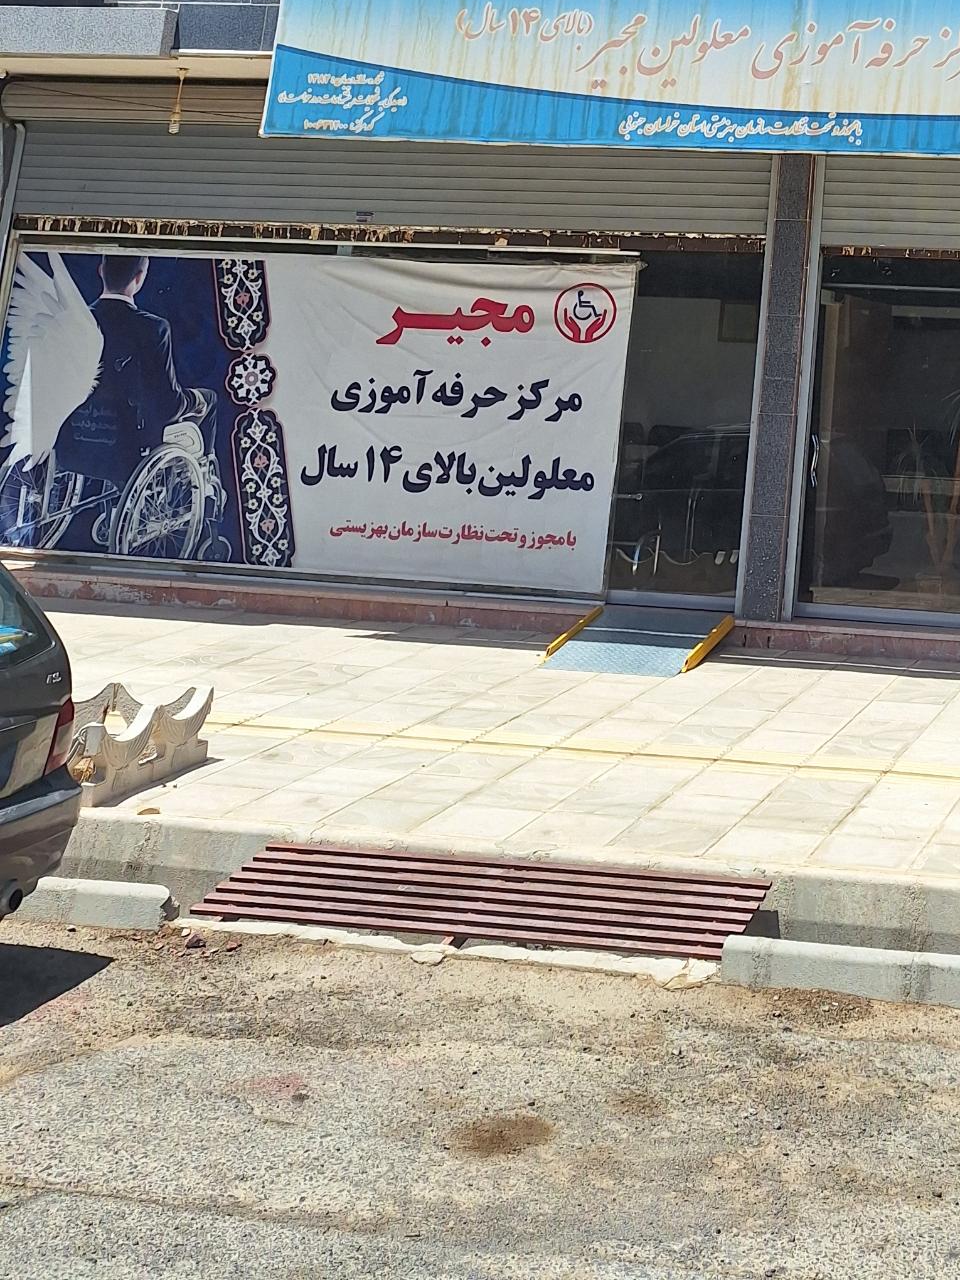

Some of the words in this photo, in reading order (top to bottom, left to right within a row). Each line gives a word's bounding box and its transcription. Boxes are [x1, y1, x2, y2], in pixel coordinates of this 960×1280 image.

[509, 8, 541, 36] ۱۴
[575, 14, 648, 89] مجیر
[636, 14, 750, 89] معلولین
[751, 18, 881, 80] آموزی
[865, 19, 930, 69] حرفه
[618, 111, 646, 141] جنوبی
[644, 111, 681, 136] خراسان
[375, 296, 535, 346] مجیر
[330, 370, 433, 414] آموزی
[431, 371, 508, 419] حرفه
[507, 379, 583, 422] مرکز
[300, 444, 358, 486] سال
[366, 444, 403, 484] ۱۴
[402, 450, 477, 494] بالای
[477, 455, 595, 500] معلولین
[329, 519, 388, 540] بهزیستی
[388, 520, 438, 543] سازمان
[439, 524, 485, 545] نظارت
[484, 527, 519, 543] تحت
